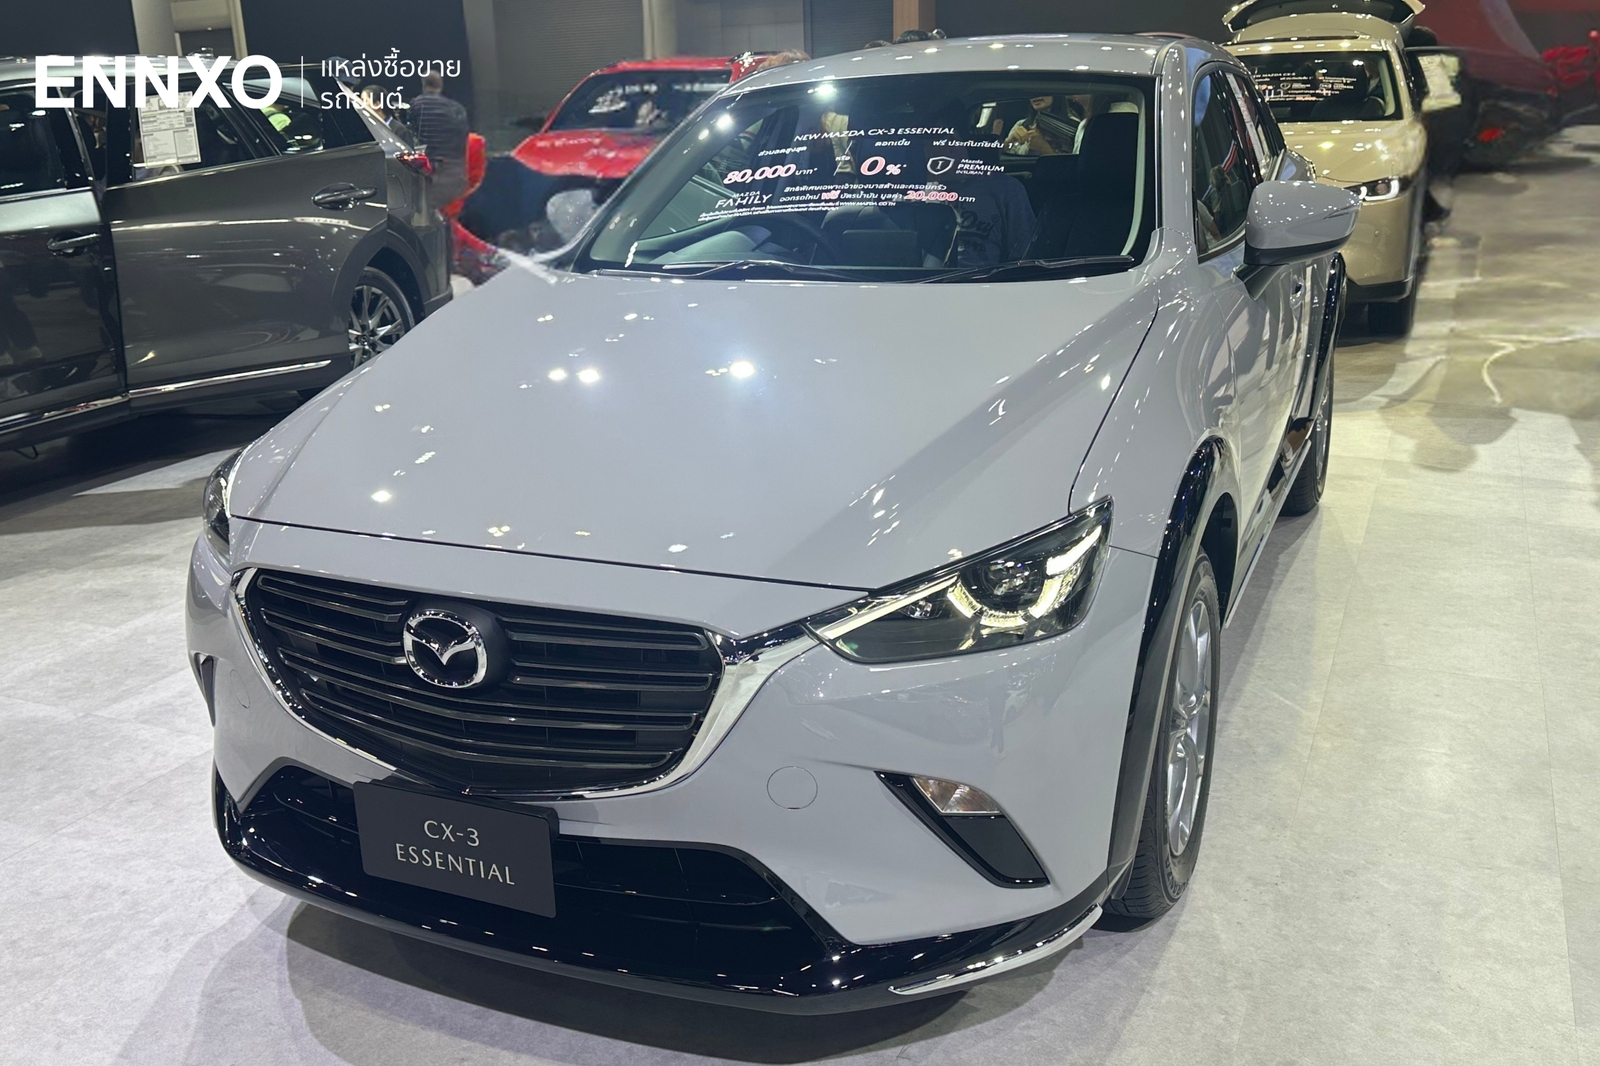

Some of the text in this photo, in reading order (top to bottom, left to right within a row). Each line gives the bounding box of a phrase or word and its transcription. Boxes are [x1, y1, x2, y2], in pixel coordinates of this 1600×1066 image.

[794, 127, 955, 142] NEW MAZDA CX-3 ESSENTIAL
[875, 138, 911, 147] ดอกเบี้ย
[932, 138, 947, 147] ฟรี
[723, 163, 796, 185] 80,000
[957, 163, 1005, 172] PREMIUM
[715, 193, 773, 209] FAMILY
[732, 190, 761, 198] MAZDA
[903, 190, 959, 202] 20,000
[958, 195, 976, 203] บาท
[423, 820, 480, 847] CX-3
[395, 843, 515, 885] ESSENTIAL
